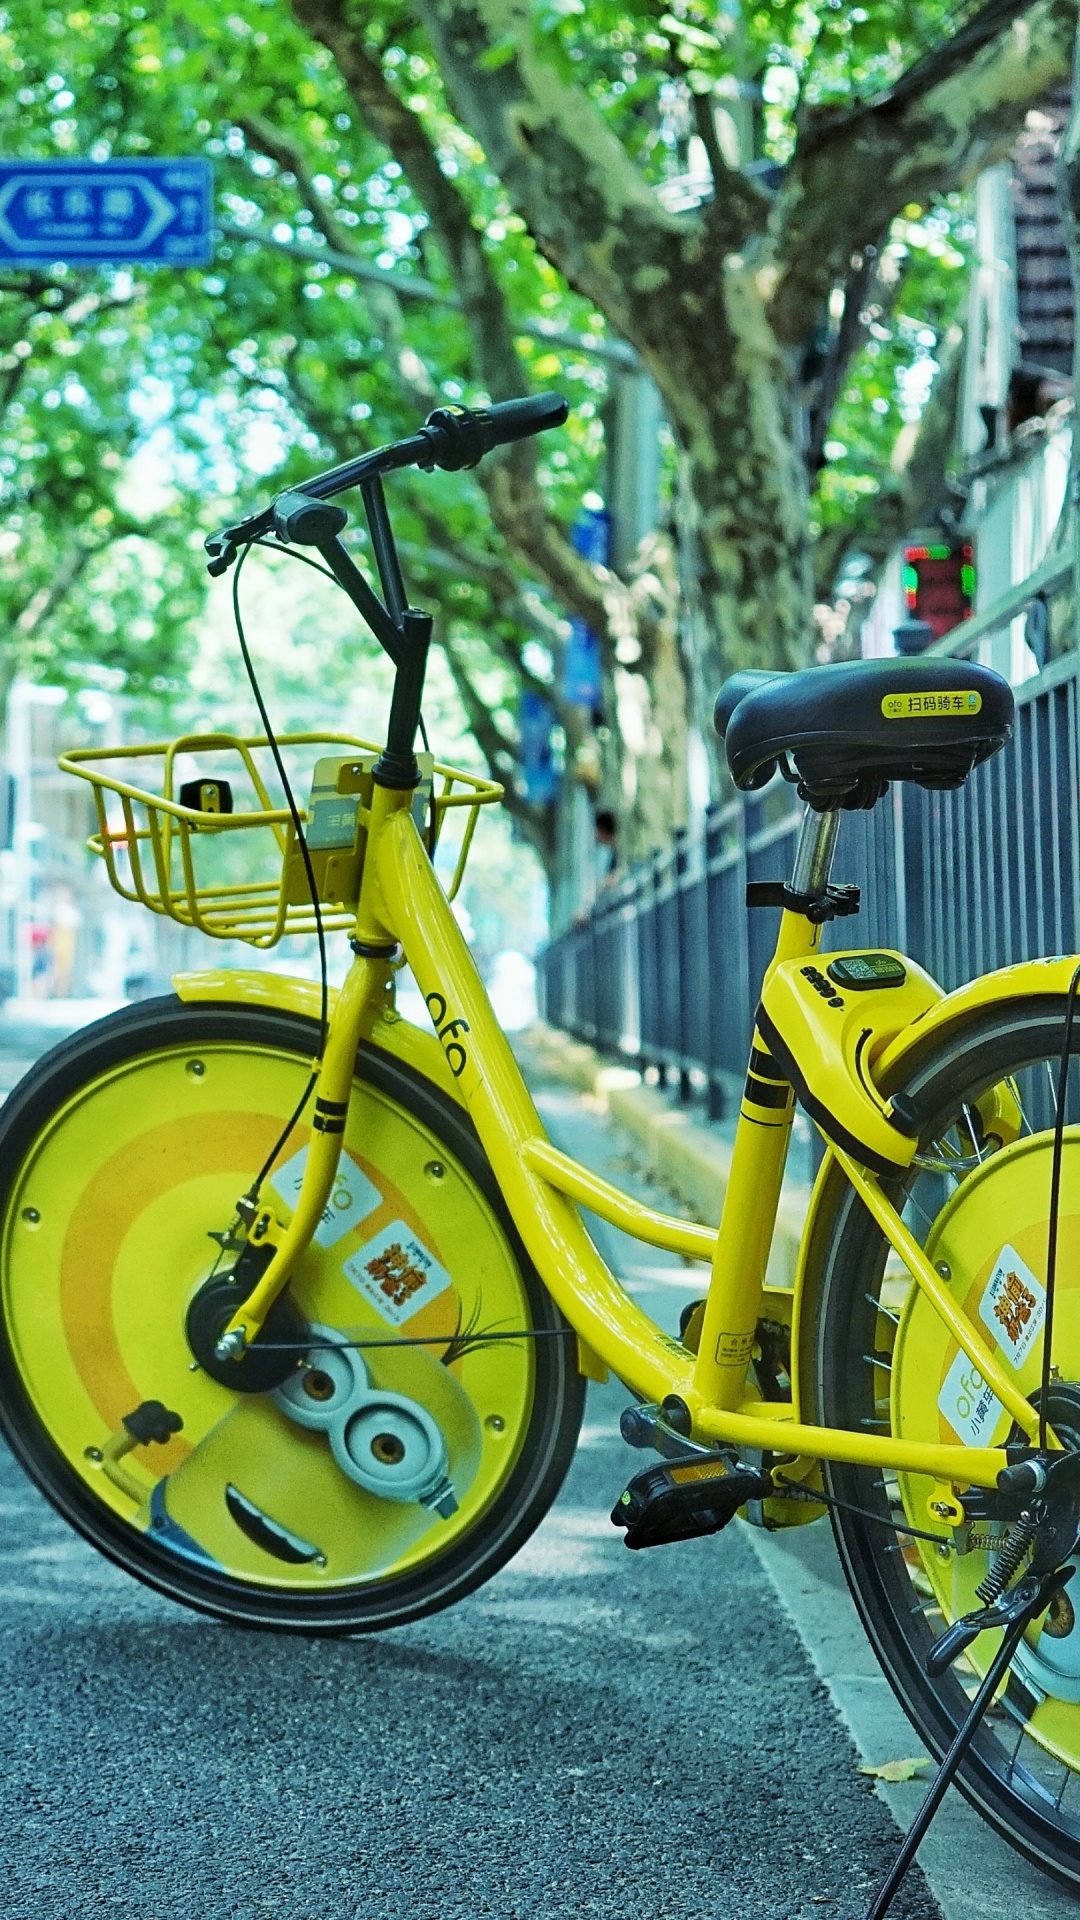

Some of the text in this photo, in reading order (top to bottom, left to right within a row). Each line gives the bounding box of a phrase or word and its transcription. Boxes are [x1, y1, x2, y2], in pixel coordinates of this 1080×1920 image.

[888, 699, 902, 708] ofo
[908, 695, 964, 712] 扫码骑车
[426, 992, 470, 1077] ofo
[993, 1271, 1024, 1327] 神偷
[957, 1368, 983, 1418] ofo
